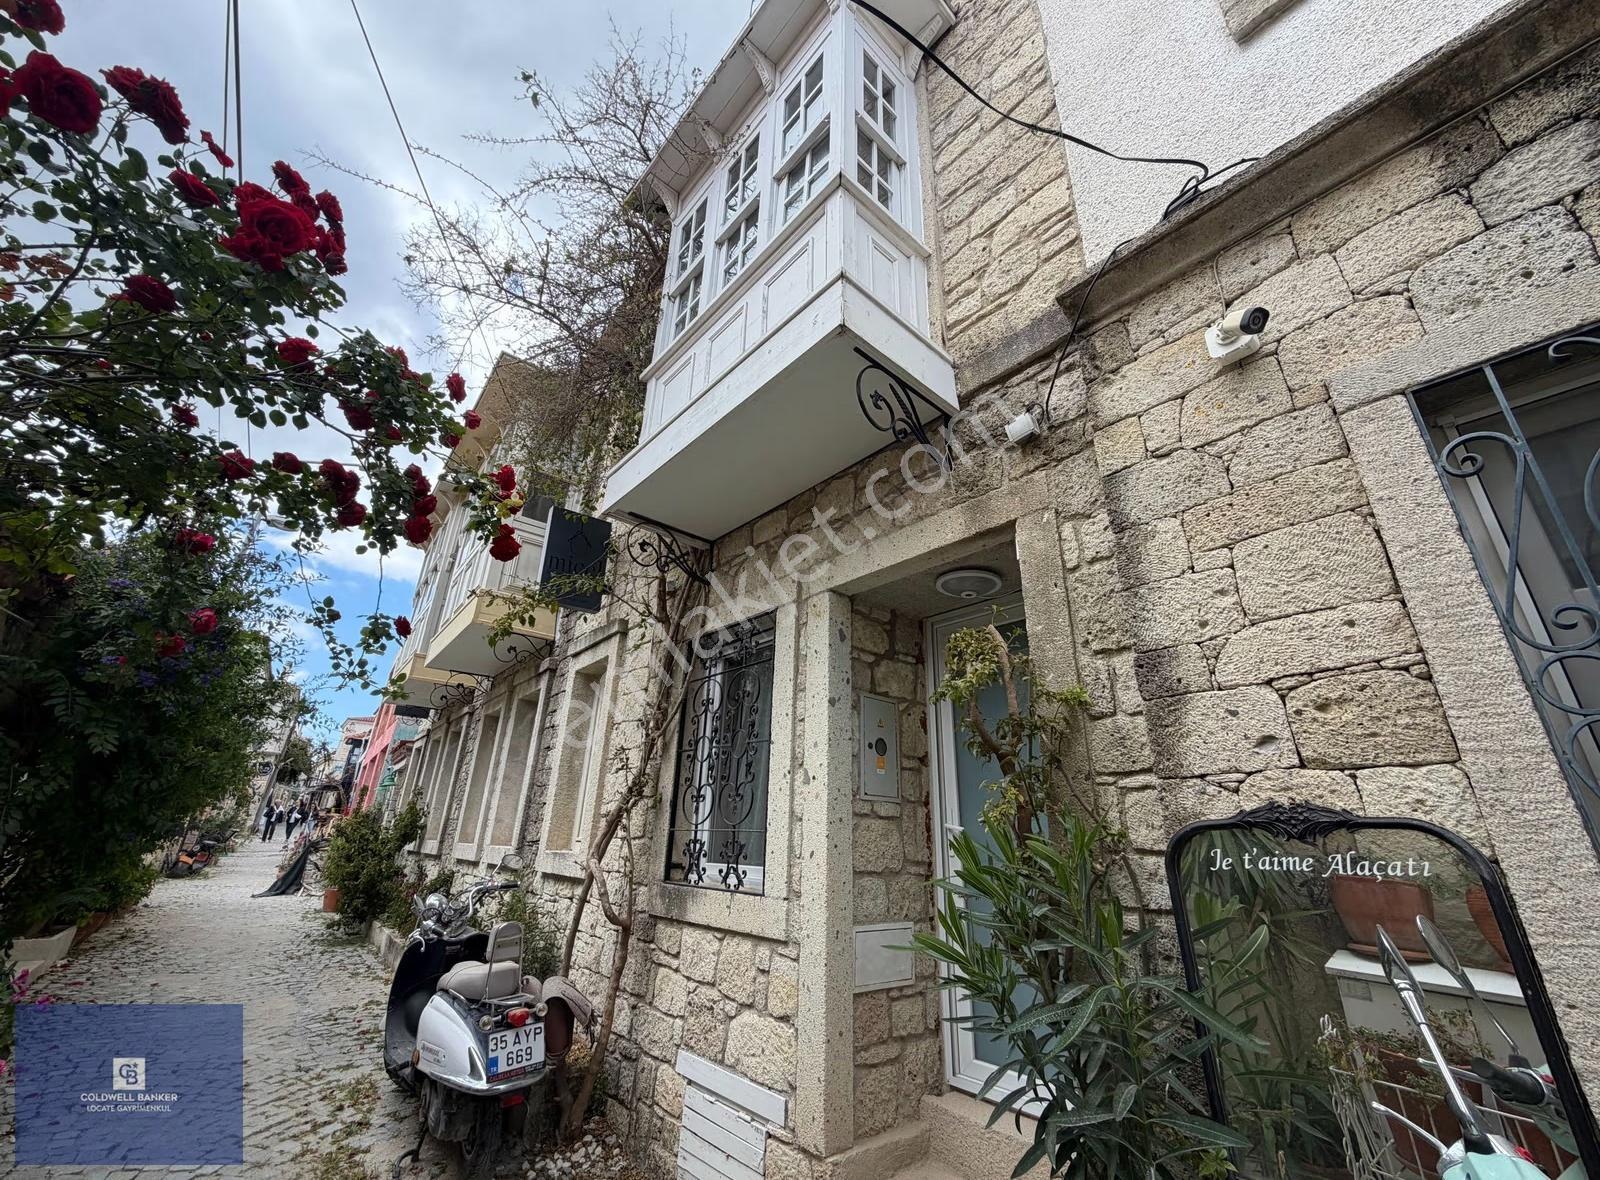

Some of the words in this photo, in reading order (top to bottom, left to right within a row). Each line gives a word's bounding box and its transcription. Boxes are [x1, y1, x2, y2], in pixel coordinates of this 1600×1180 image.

[1210, 848, 1233, 871] Je
[1242, 847, 1313, 872] t'aime
[1322, 850, 1433, 882] Alaçatı
[490, 1034, 508, 1052] 35
[512, 1026, 543, 1046] AYP
[506, 1046, 533, 1067] 669
